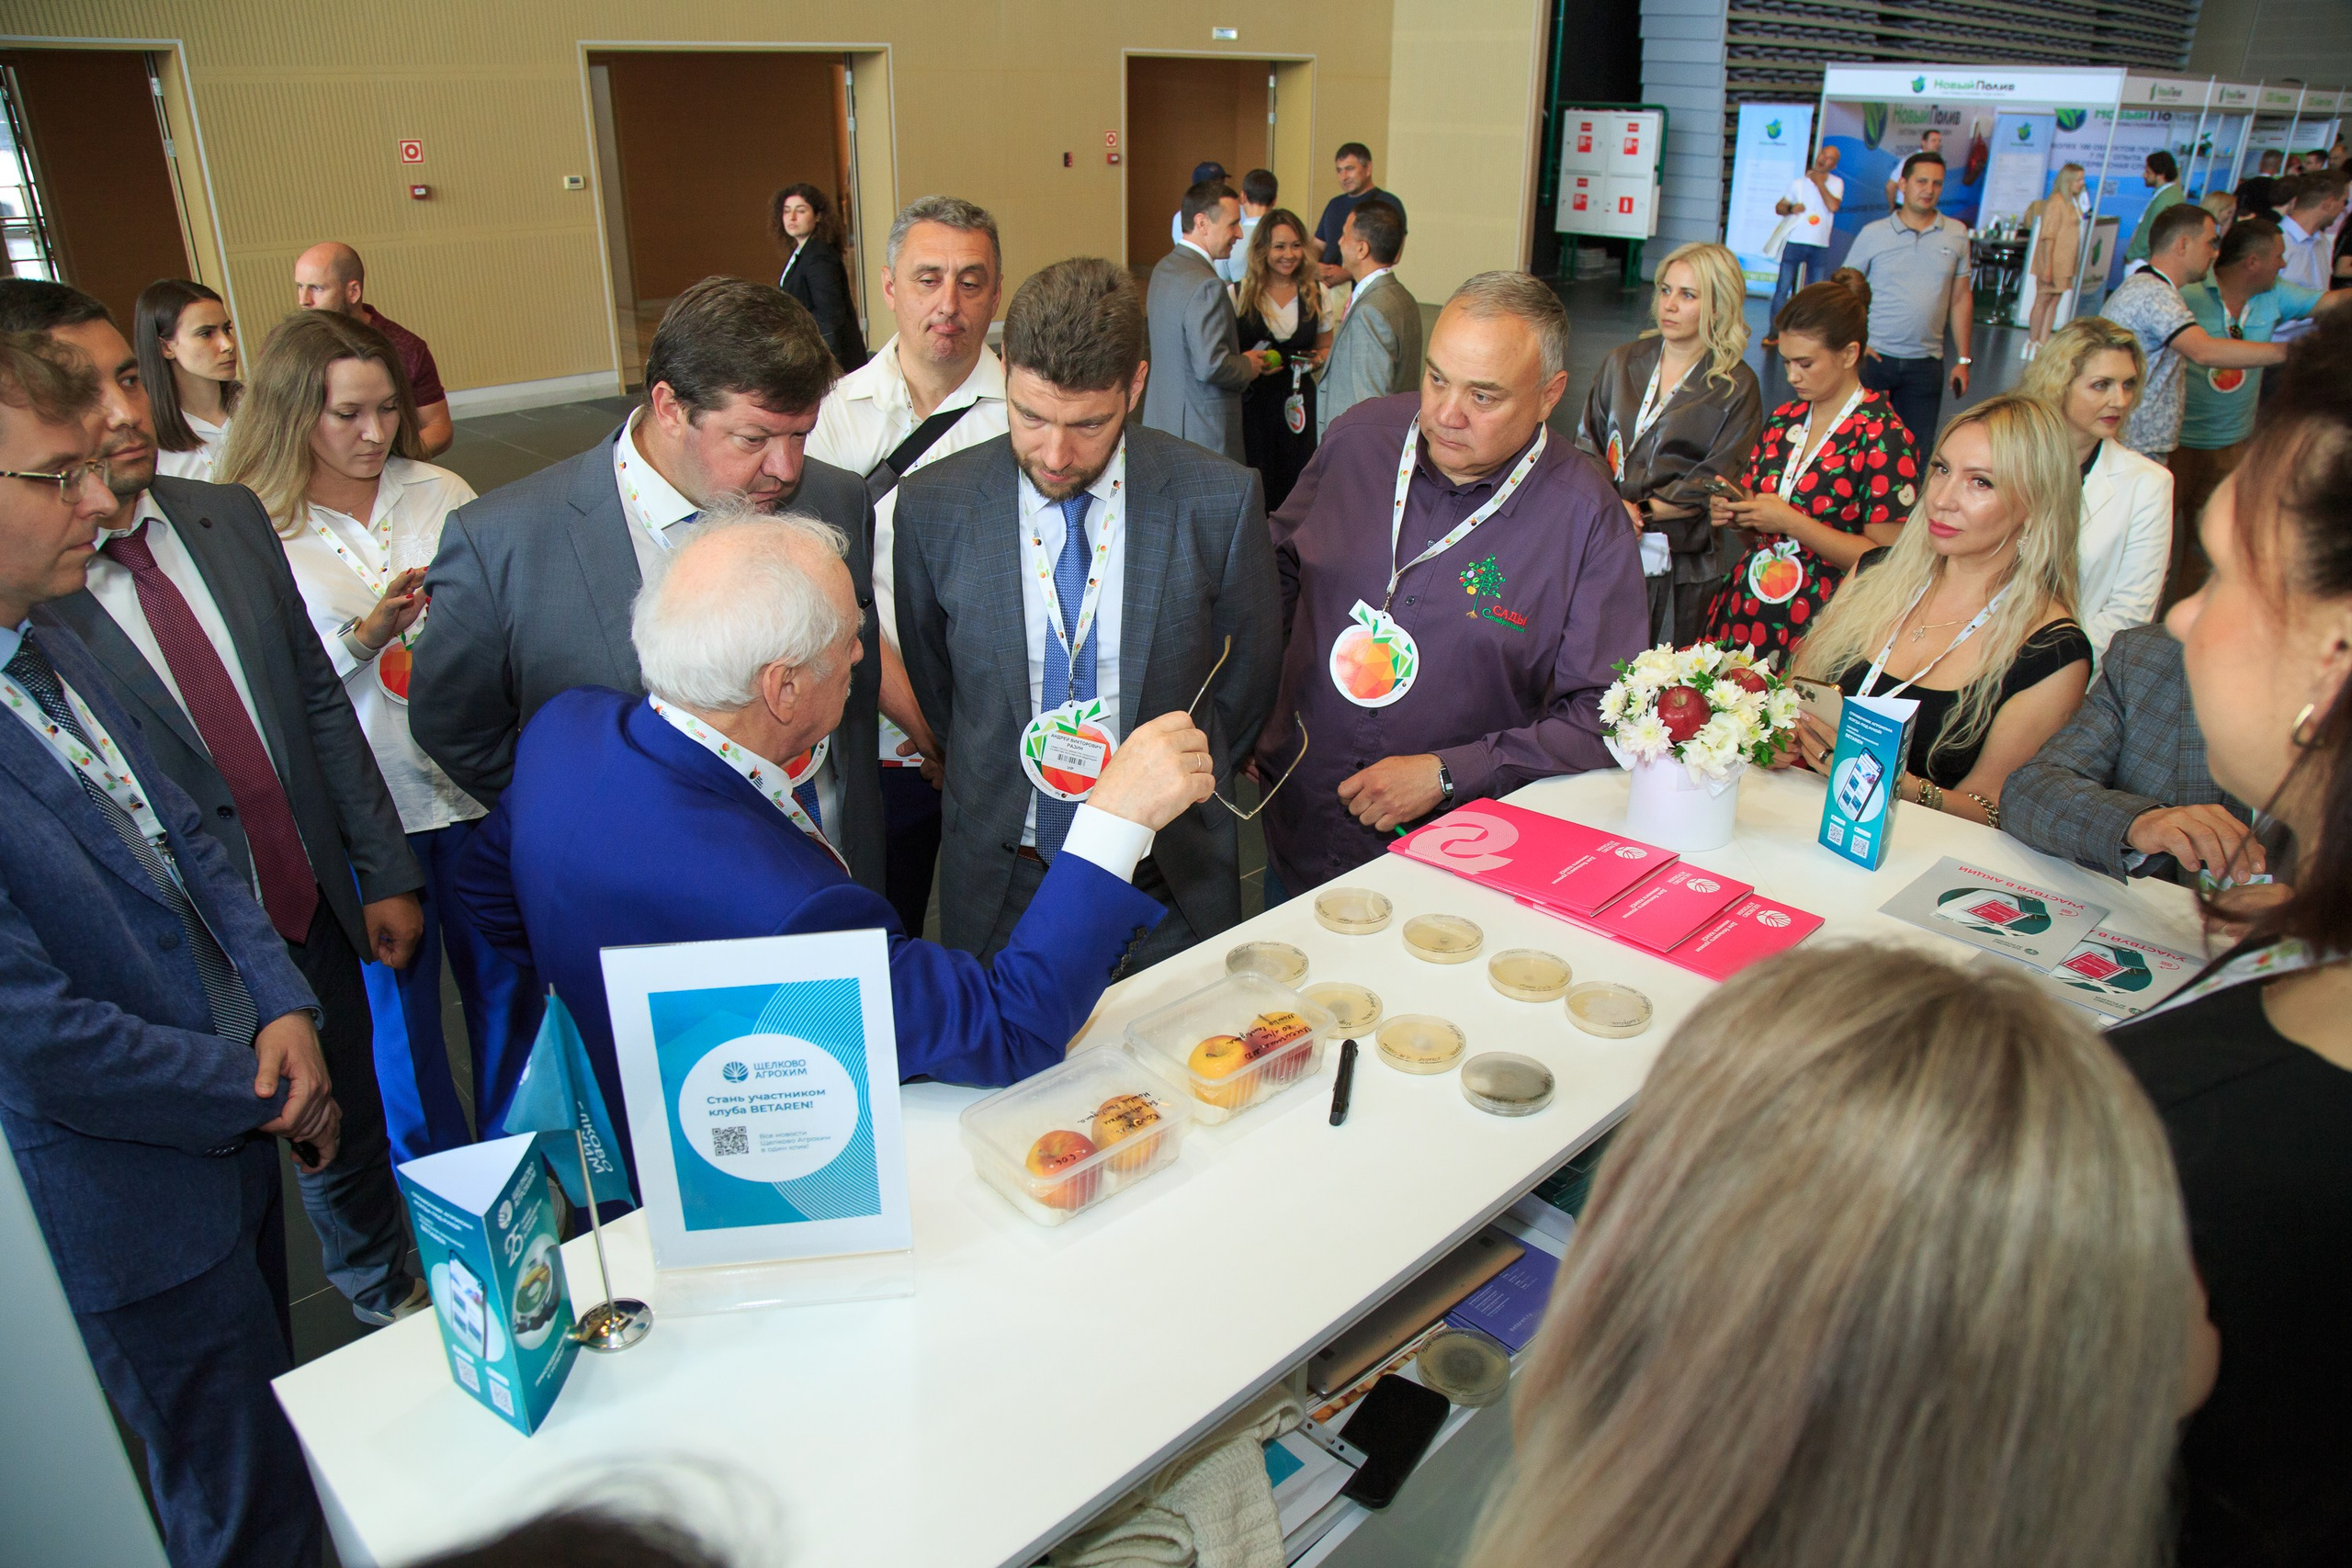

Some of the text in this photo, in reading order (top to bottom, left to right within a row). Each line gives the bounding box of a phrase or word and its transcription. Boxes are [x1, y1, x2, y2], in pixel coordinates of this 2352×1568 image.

[1492, 605, 1528, 626] САДЫ
[1958, 865, 2005, 884] АКЦИИ
[2017, 885, 2086, 910] УЧАСТВУЙ
[2110, 935, 2188, 963] УЧАСТВУЙ
[753, 1059, 807, 1071] ЩЕЛКОВО
[755, 1067, 808, 1079] АГРОХИМ
[707, 1089, 826, 1105] Стань участником
[708, 1100, 813, 1117] клуба BETAREN!
[578, 1100, 614, 1172] ЛКОВО
[797, 1135, 831, 1144] Агрохим
